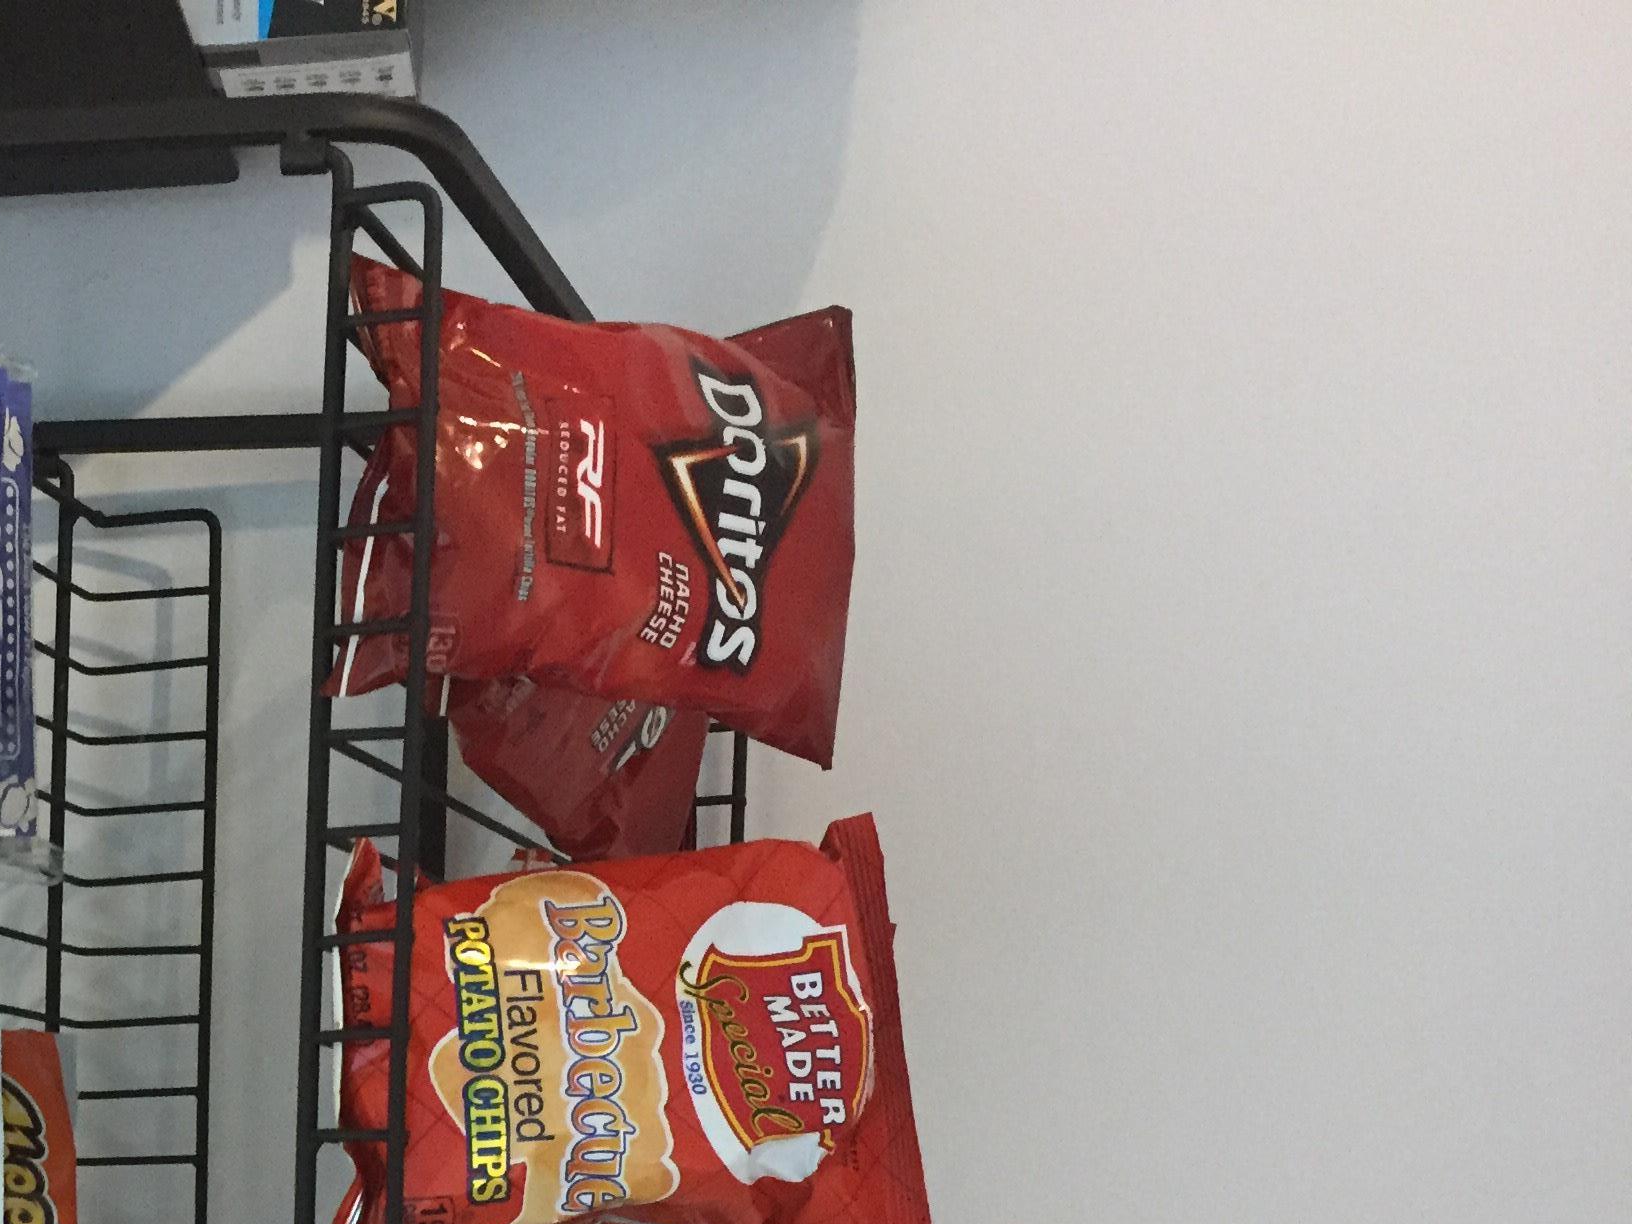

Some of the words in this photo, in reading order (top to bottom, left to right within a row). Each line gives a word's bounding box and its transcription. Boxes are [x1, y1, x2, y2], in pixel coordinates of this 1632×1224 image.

[555, 506, 567, 533] FAT
[556, 421, 571, 497] REDUCED
[576, 418, 605, 549] RF
[697, 372, 767, 667] Doritos
[640, 551, 675, 644] CHEESE
[659, 563, 690, 648] NACHO
[598, 700, 636, 753] ACHO
[447, 918, 501, 1070] POTATO
[504, 968, 554, 1143] Flavored
[543, 897, 637, 1214] Barbecue
[681, 961, 804, 1138] Special
[763, 996, 815, 1101] MADE
[791, 972, 846, 1124] BETTER
[684, 1052, 708, 1096] 1930
[466, 1075, 508, 1203] CHIPS
